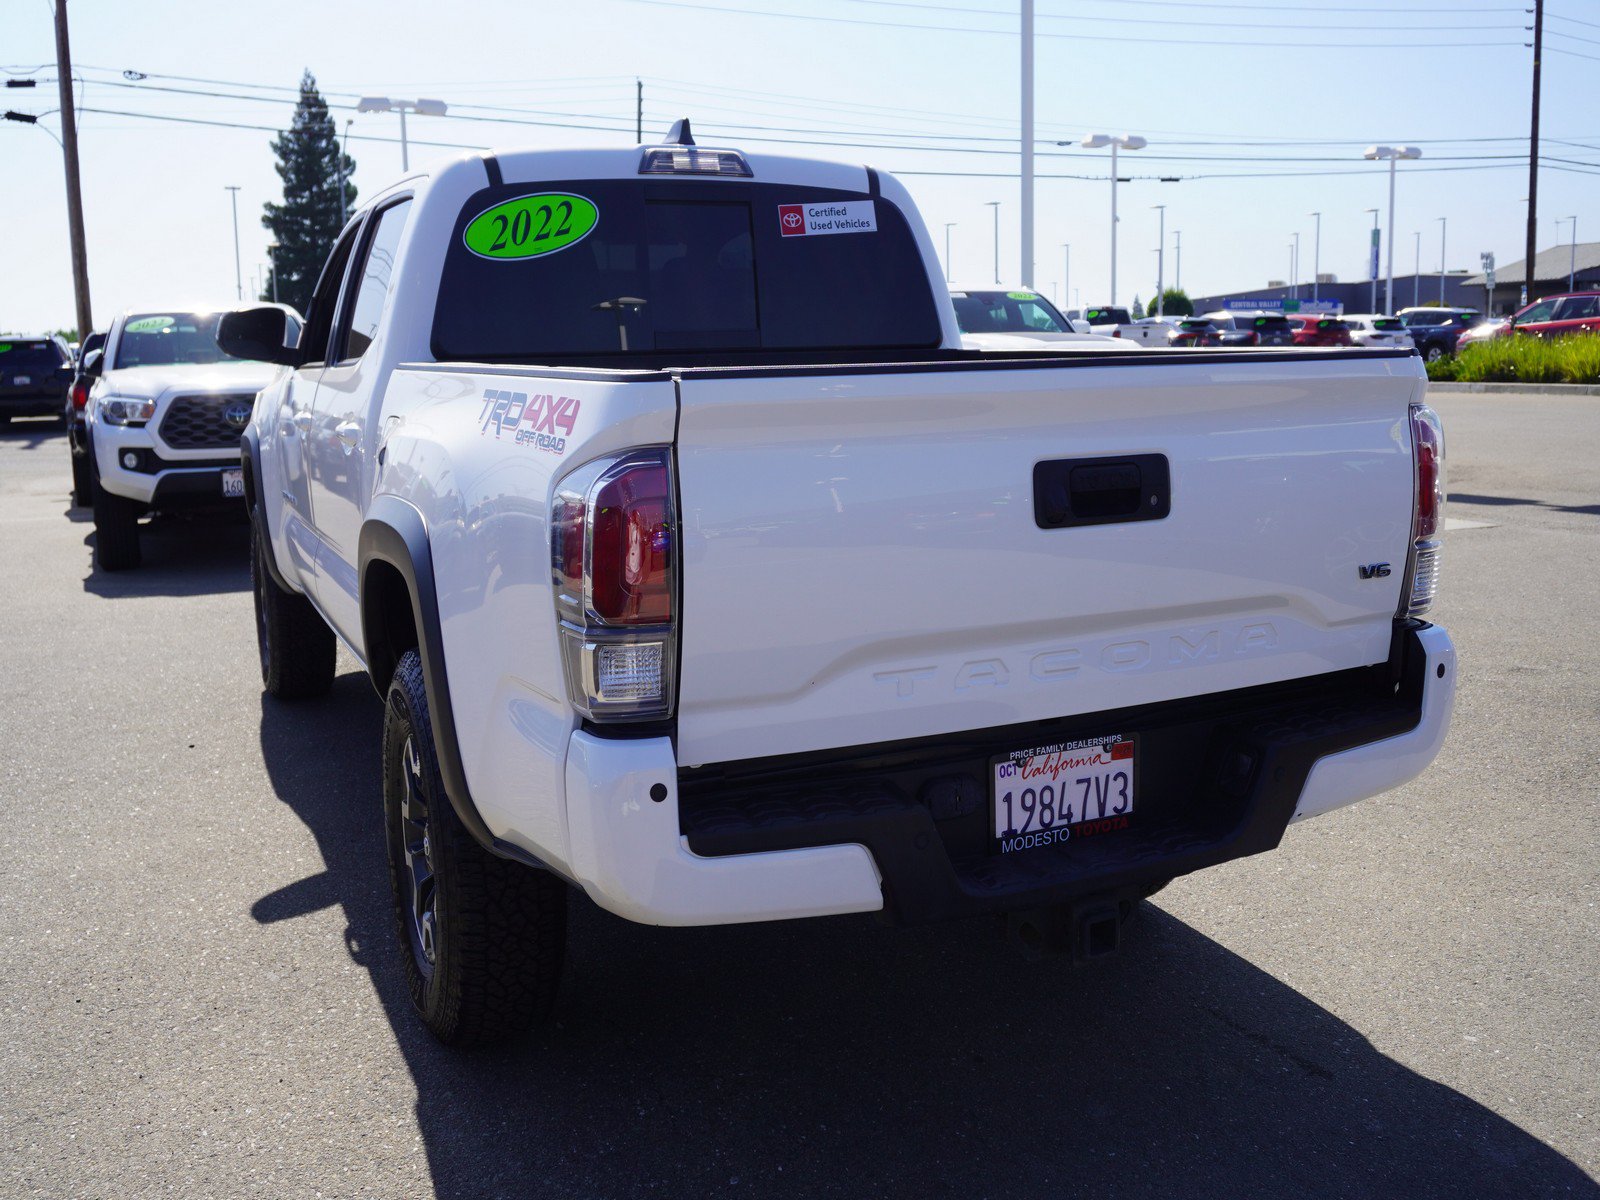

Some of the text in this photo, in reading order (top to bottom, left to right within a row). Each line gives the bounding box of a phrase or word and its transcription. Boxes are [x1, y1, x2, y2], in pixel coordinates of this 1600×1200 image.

[489, 200, 573, 252] 2022
[808, 206, 847, 218] Certified
[810, 219, 871, 230] Used Vehicles
[1258, 300, 1282, 308] VALLEY
[479, 389, 528, 438] TRD
[535, 433, 566, 455] ROAD
[1358, 562, 1391, 580] V6
[873, 620, 1281, 700] TACOMA
[1009, 734, 1122, 760] PRICE FAMILY DEALERSHIPS
[1000, 763, 1018, 779] OCT
[1021, 748, 1112, 781] California
[1002, 771, 1128, 837] 19847V3
[1002, 816, 1130, 854] MODESTO TOYOTA
